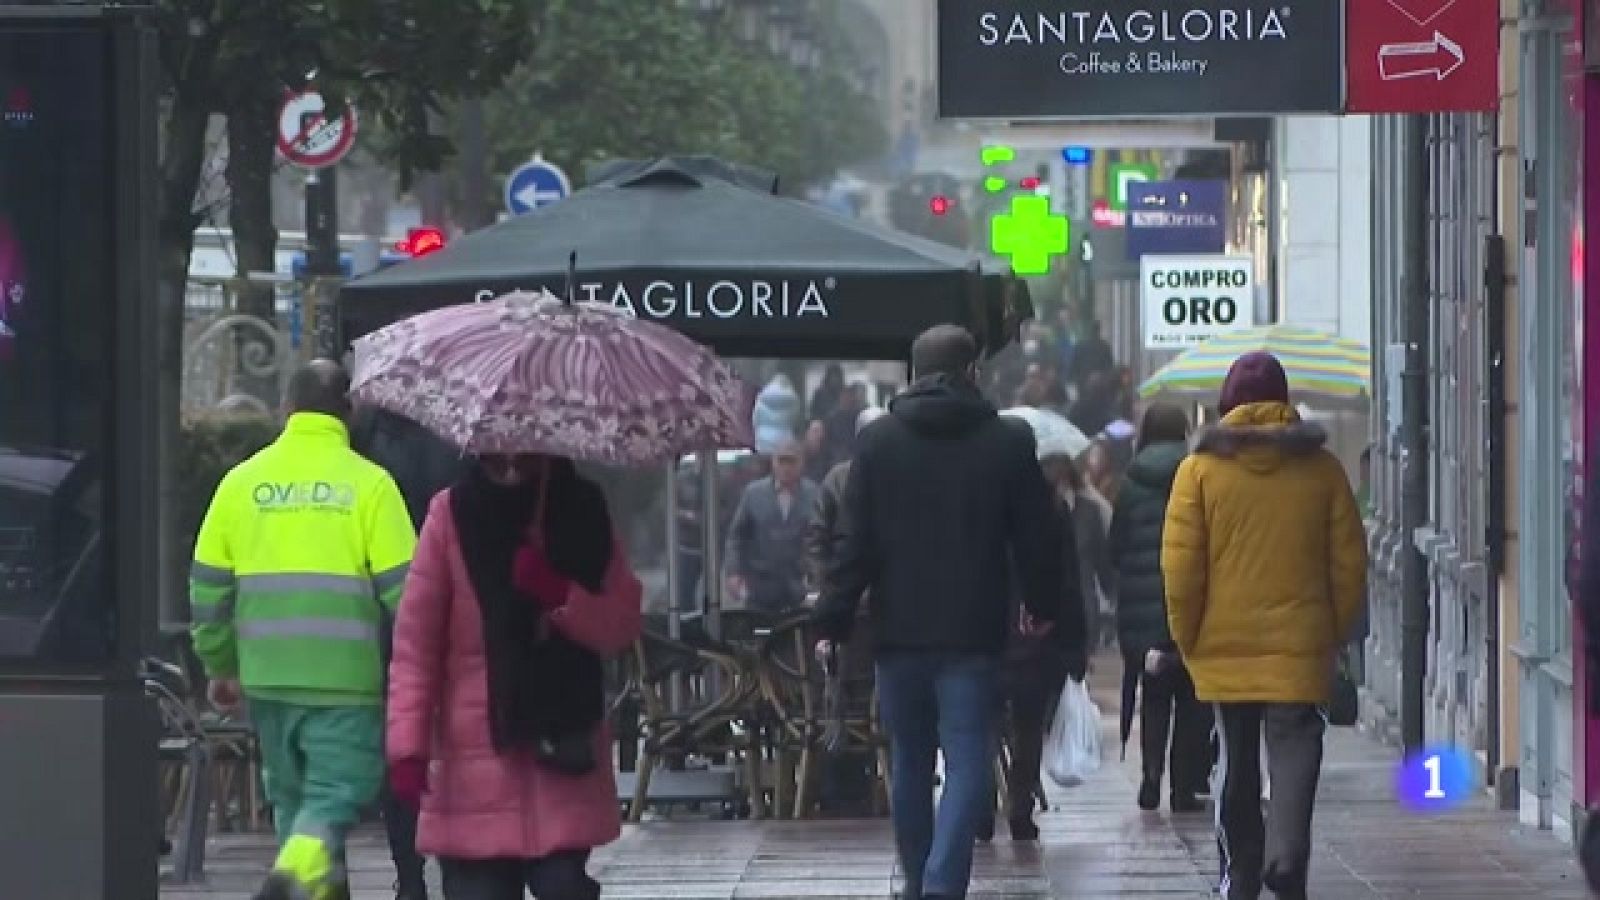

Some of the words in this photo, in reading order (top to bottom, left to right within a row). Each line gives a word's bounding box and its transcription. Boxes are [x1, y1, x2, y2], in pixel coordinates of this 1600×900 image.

[979, 8, 1287, 45] SANTAGLORIA
[1060, 51, 1121, 74] Coffee
[1125, 51, 1143, 74] &
[1147, 50, 1208, 76] Bakery
[1151, 269, 1248, 289] COMPRO
[1163, 296, 1237, 326] ORO
